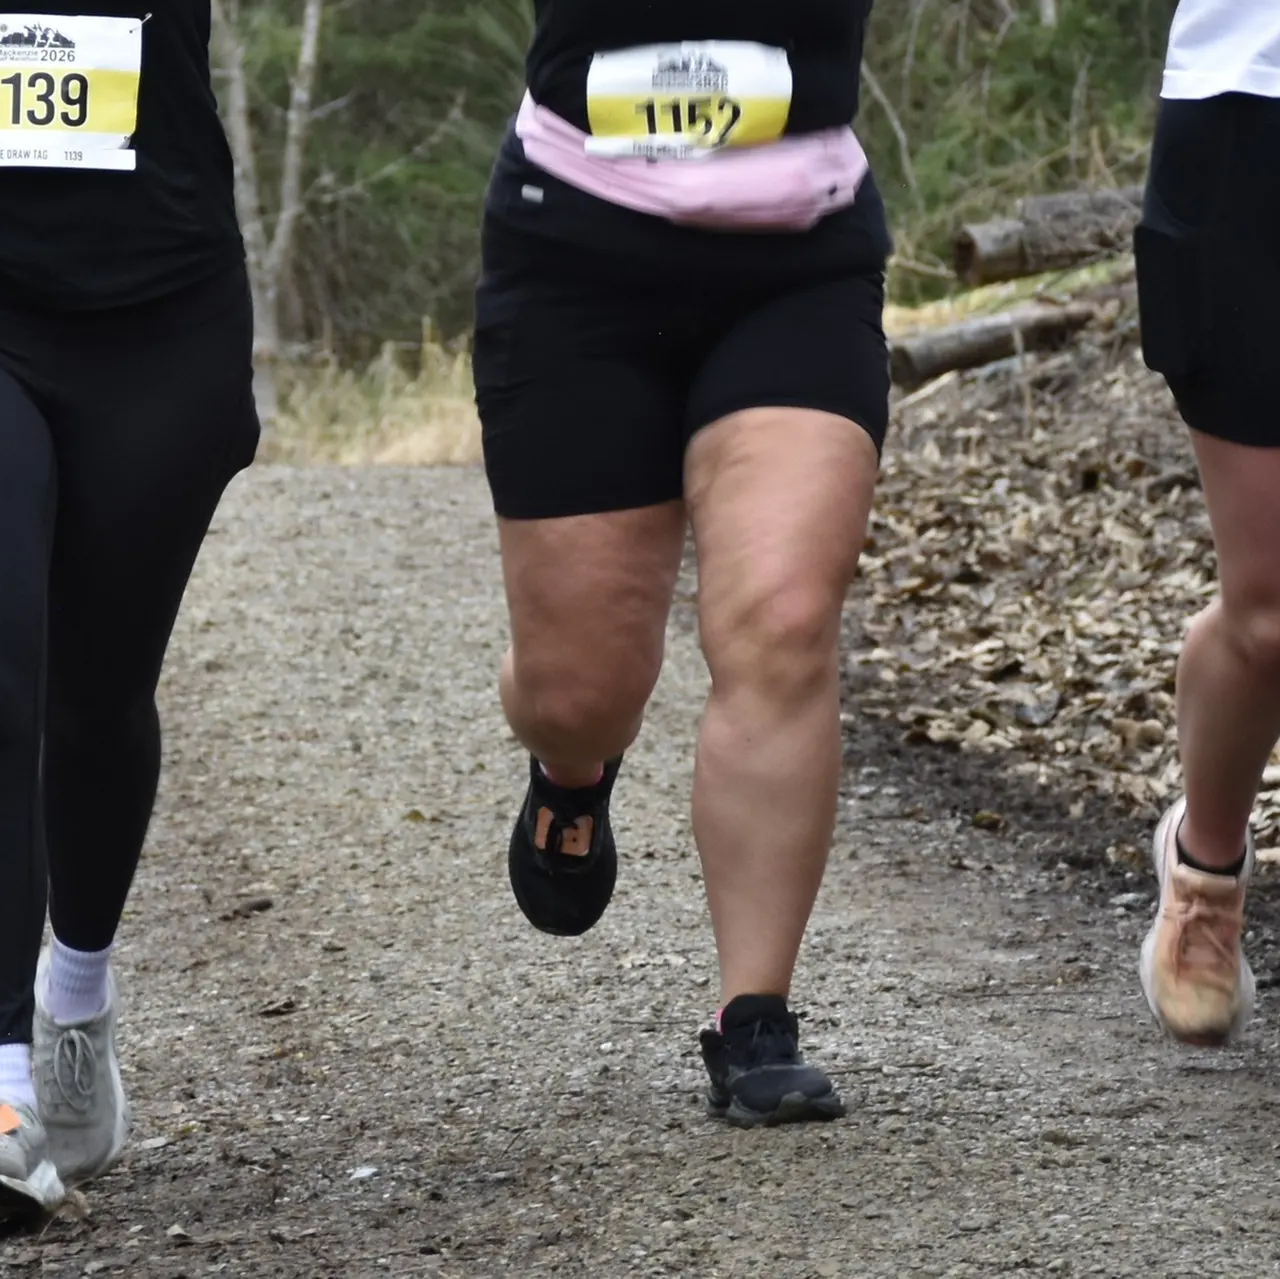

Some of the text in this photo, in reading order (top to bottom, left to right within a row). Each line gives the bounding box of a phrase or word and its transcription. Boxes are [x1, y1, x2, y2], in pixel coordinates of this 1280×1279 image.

[40, 49, 76, 62] 2026
[635, 96, 741, 148] 1152
[7, 149, 31, 160] DRAW
[33, 149, 48, 160] TAG
[64, 150, 83, 161] 1139
